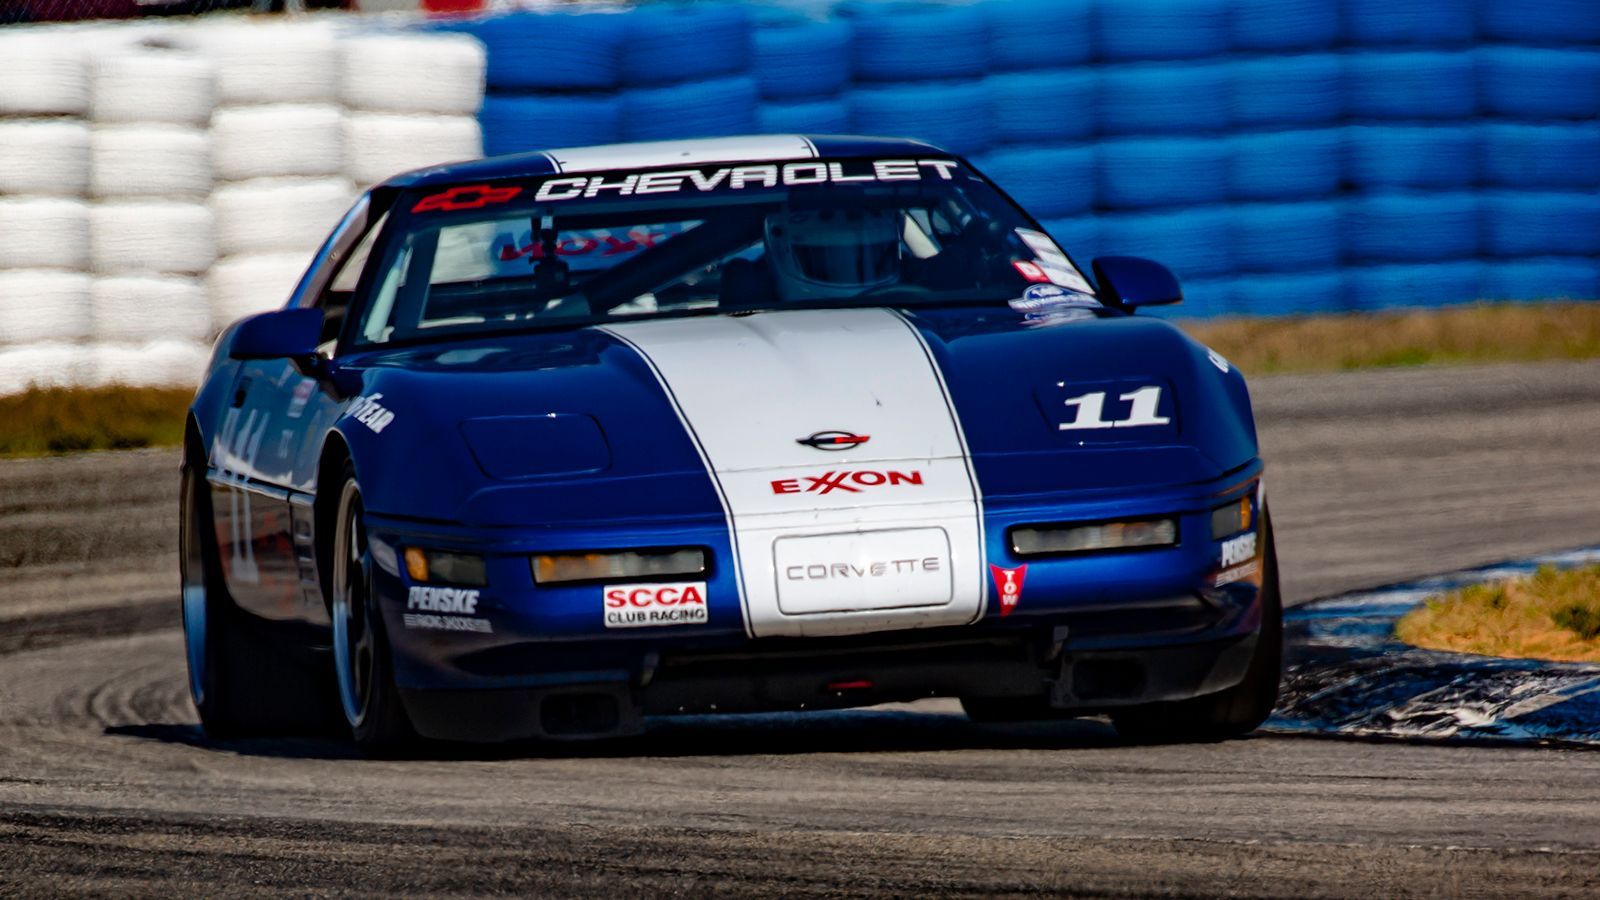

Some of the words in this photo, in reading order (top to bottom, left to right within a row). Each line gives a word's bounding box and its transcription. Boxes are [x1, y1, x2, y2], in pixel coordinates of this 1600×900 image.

[535, 159, 958, 201] CHEVROLET
[1059, 386, 1171, 430] 11
[770, 470, 924, 495] EXXON
[786, 556, 940, 581] CORVETTE
[408, 586, 480, 614] PENSKE
[606, 585, 704, 608] SCCA
[1002, 570, 1019, 606] TOW
[608, 610, 647, 623] CLUB
[650, 608, 706, 622] RACING
